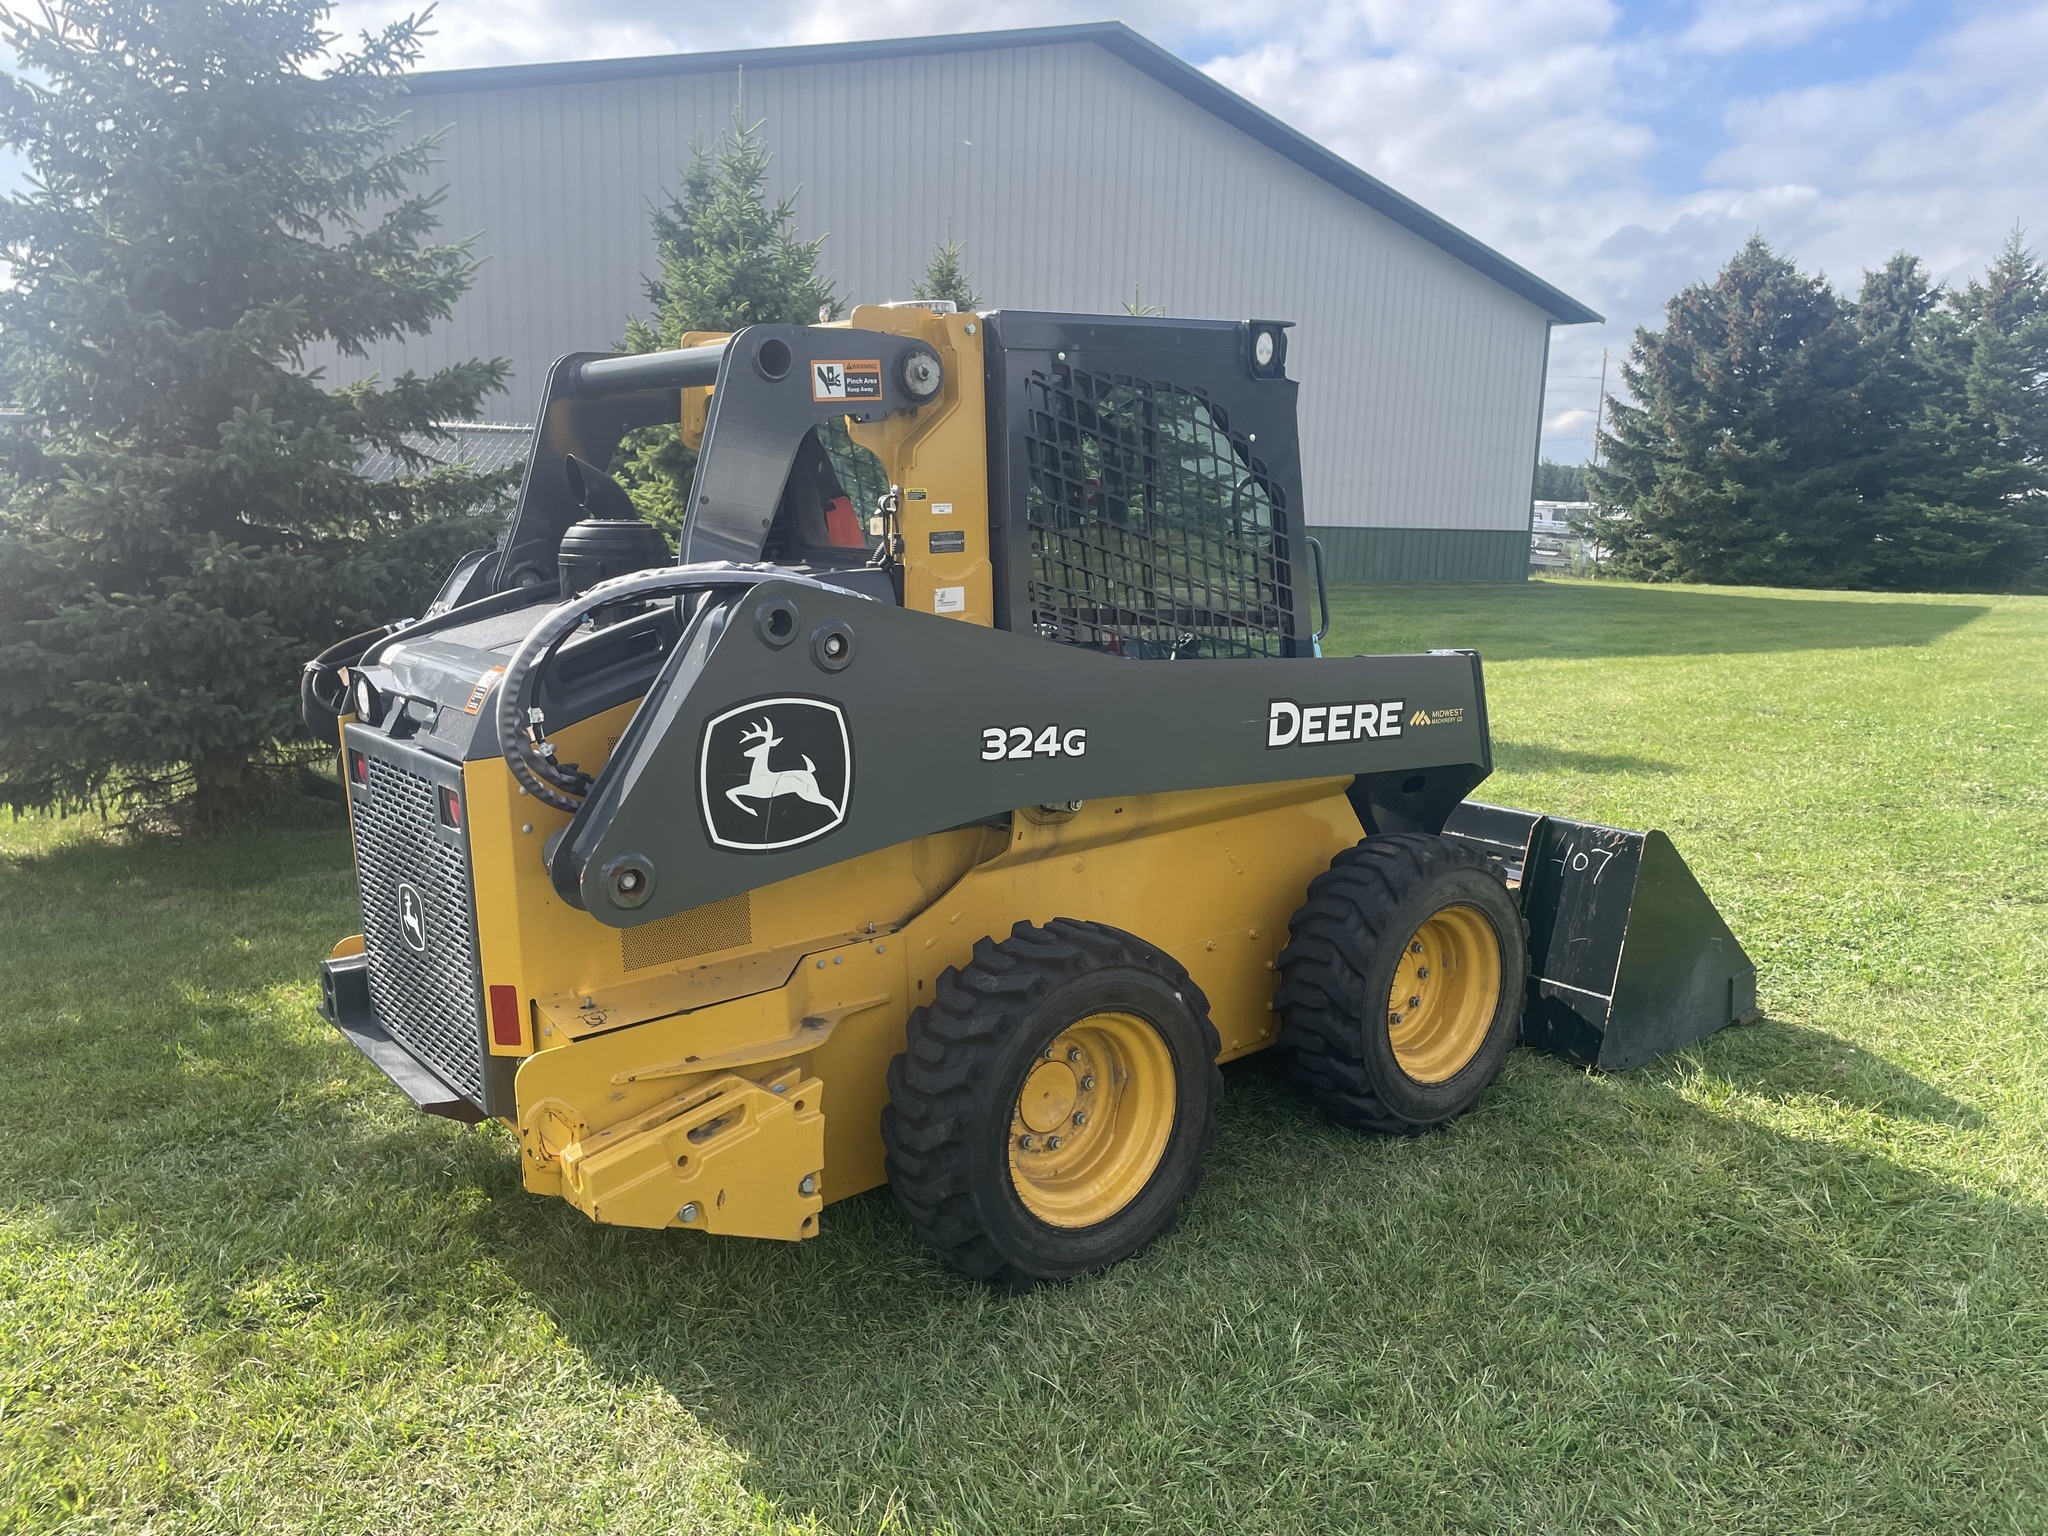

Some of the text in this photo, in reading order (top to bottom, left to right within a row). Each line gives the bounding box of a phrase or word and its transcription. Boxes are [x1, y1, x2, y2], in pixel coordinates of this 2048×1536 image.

[1268, 701, 1403, 746] DEERE
[1432, 708, 1464, 718] MIDWEST
[981, 726, 1086, 760] 324G
